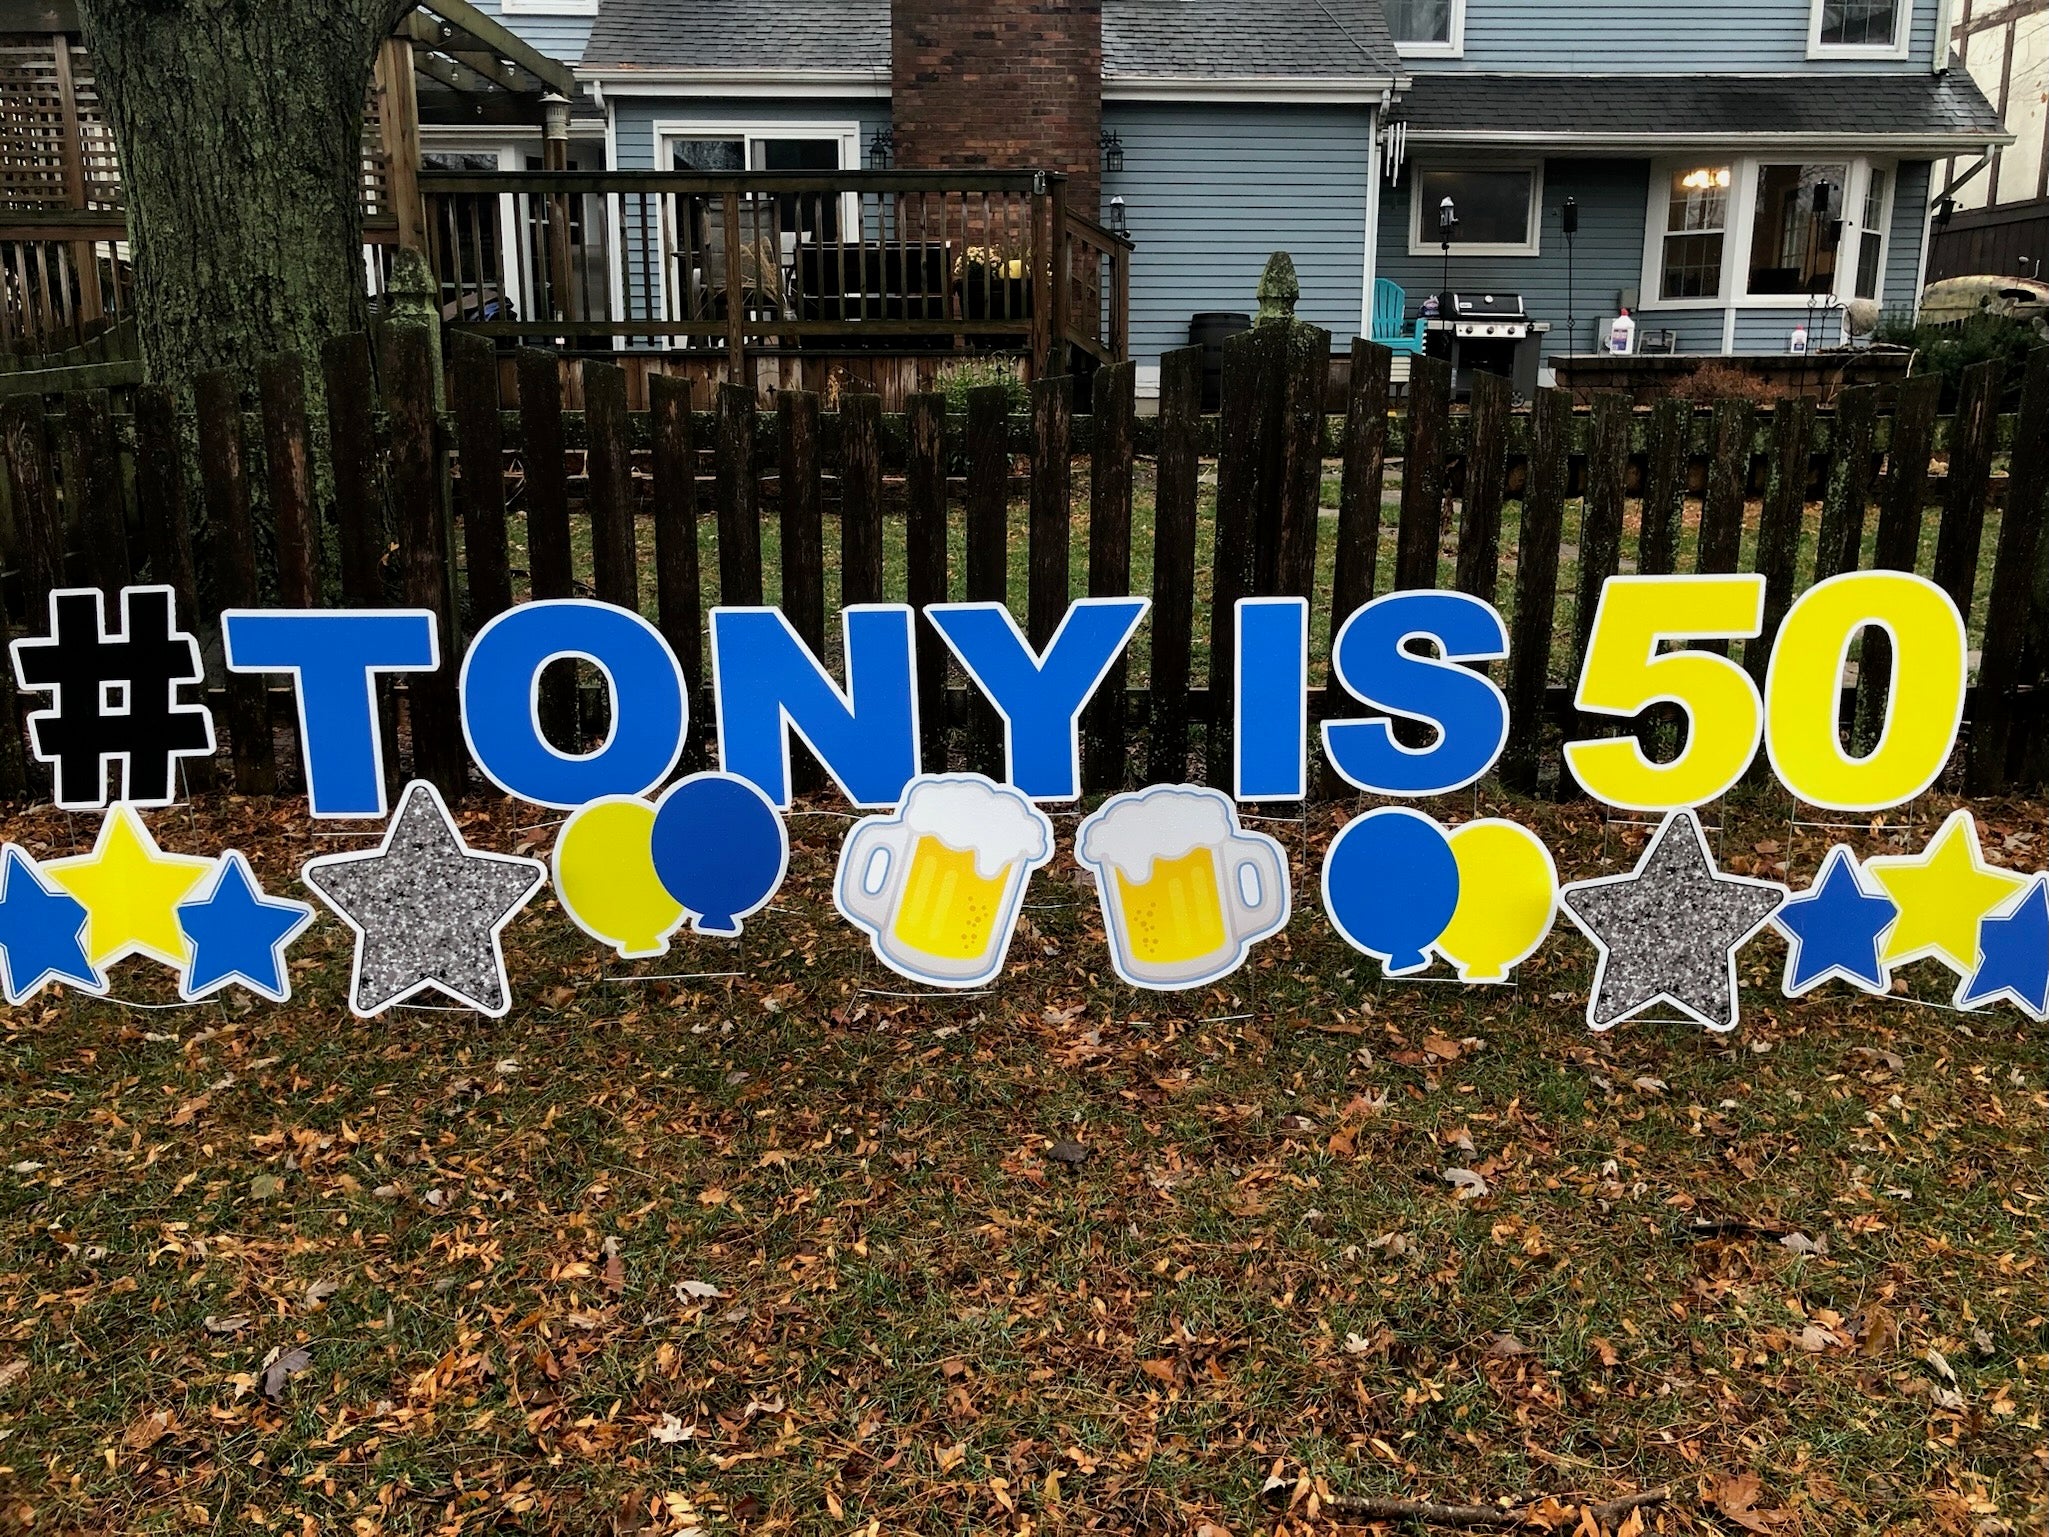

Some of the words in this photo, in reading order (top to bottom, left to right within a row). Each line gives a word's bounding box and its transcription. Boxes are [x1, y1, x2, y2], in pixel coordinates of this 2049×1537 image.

[9, 585, 1151, 818] #TONY
[1235, 589, 1510, 801] IS
[1563, 570, 1967, 812] 50
